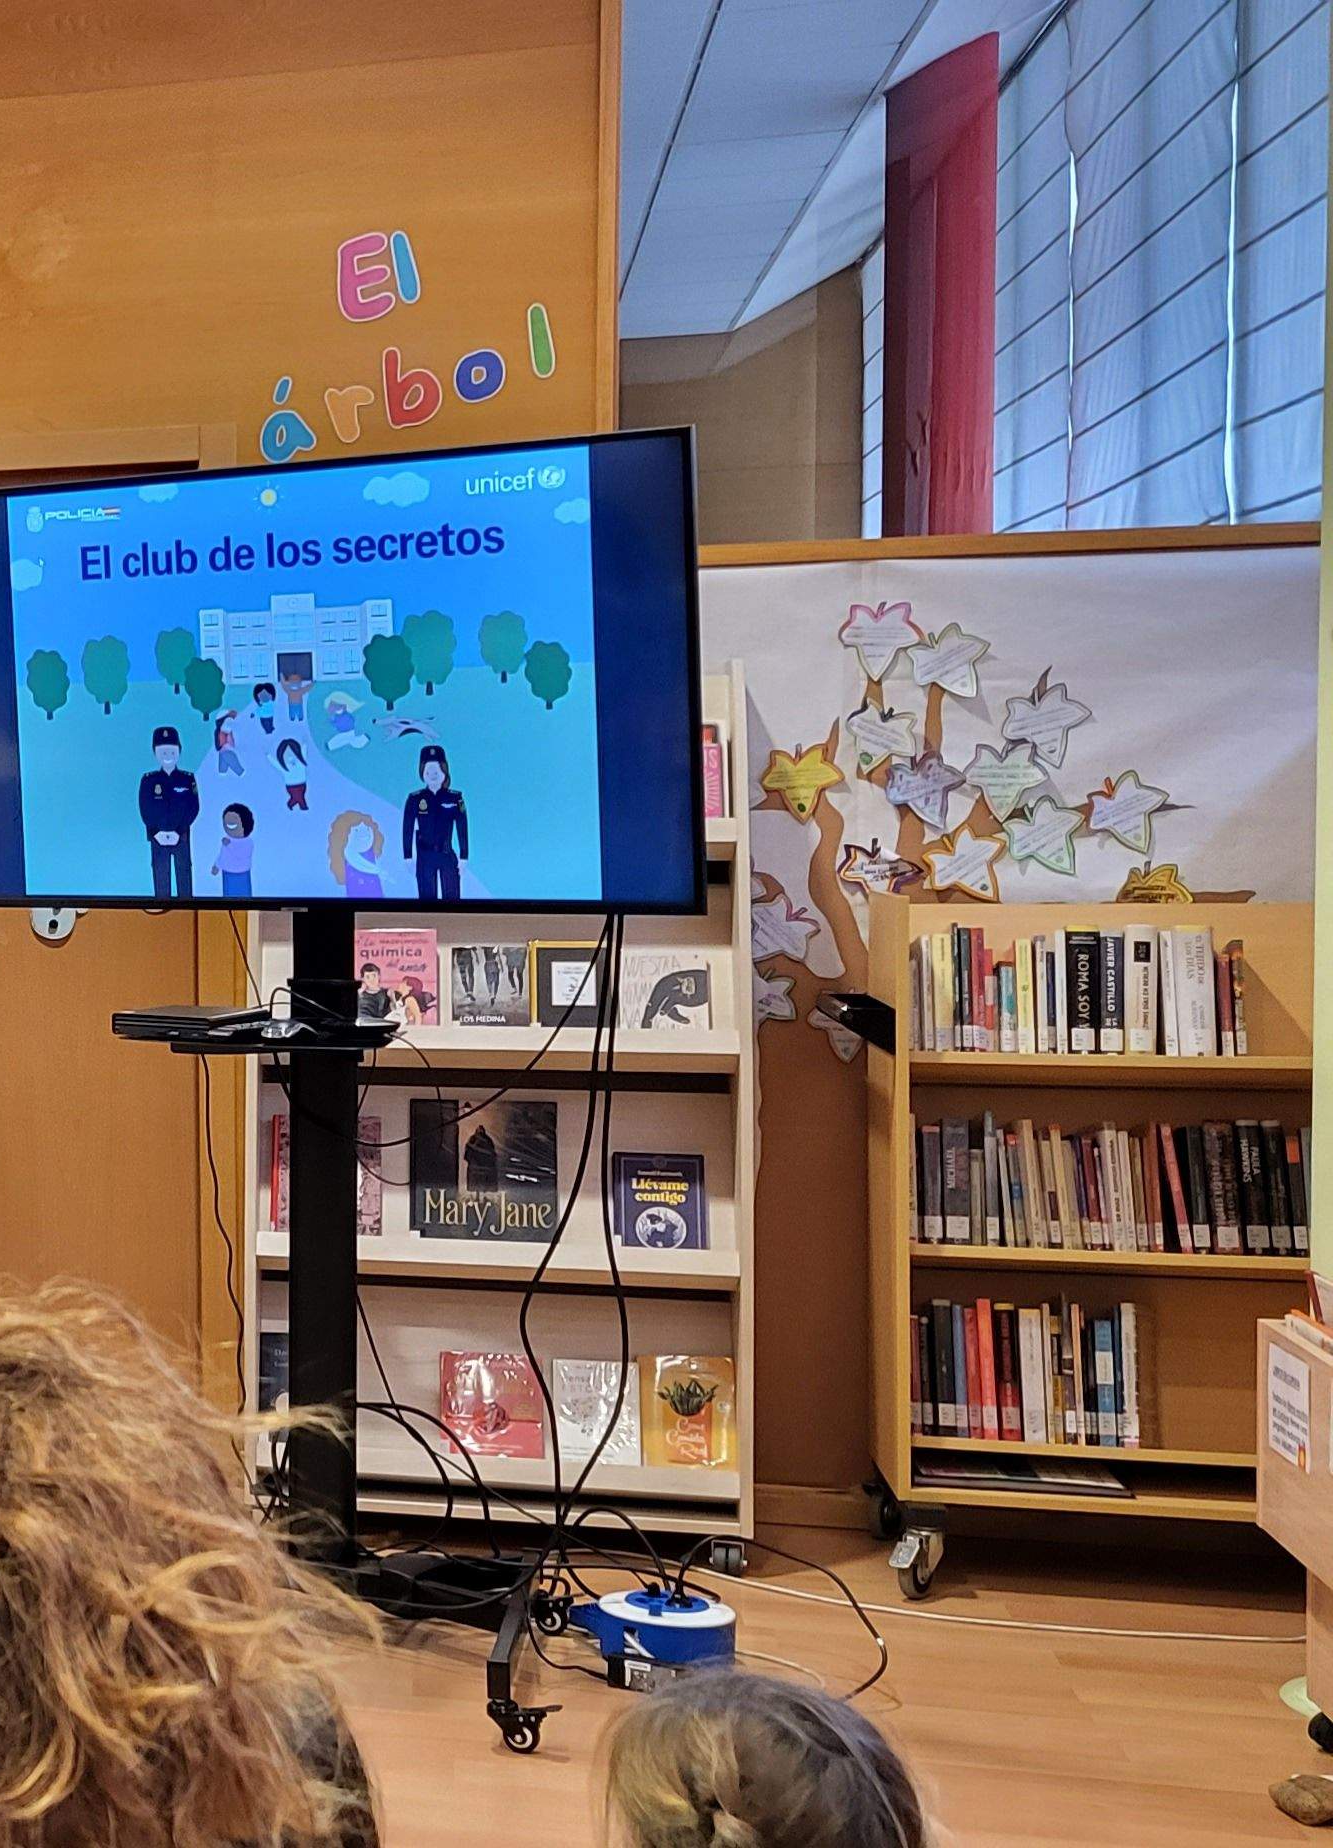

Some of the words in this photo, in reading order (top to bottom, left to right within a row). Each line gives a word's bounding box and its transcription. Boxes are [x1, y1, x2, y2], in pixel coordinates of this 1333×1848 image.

[337, 230, 421, 322] El
[260, 303, 556, 464] árbol
[464, 467, 536, 496] unicef
[79, 544, 112, 582] El
[121, 539, 199, 579] club
[208, 535, 256, 573] de
[265, 531, 323, 569] los
[331, 523, 507, 565] secretos
[1106, 937, 1117, 968] JAVIER
[1077, 953, 1091, 992] ROMA
[1106, 968, 1117, 1013] CASTILLO
[1077, 994, 1091, 1020] SOY
[631, 1176, 689, 1192] Llévame
[634, 1190, 686, 1206] contigo
[423, 1188, 492, 1236] Mary
[489, 1189, 554, 1234] Jane
